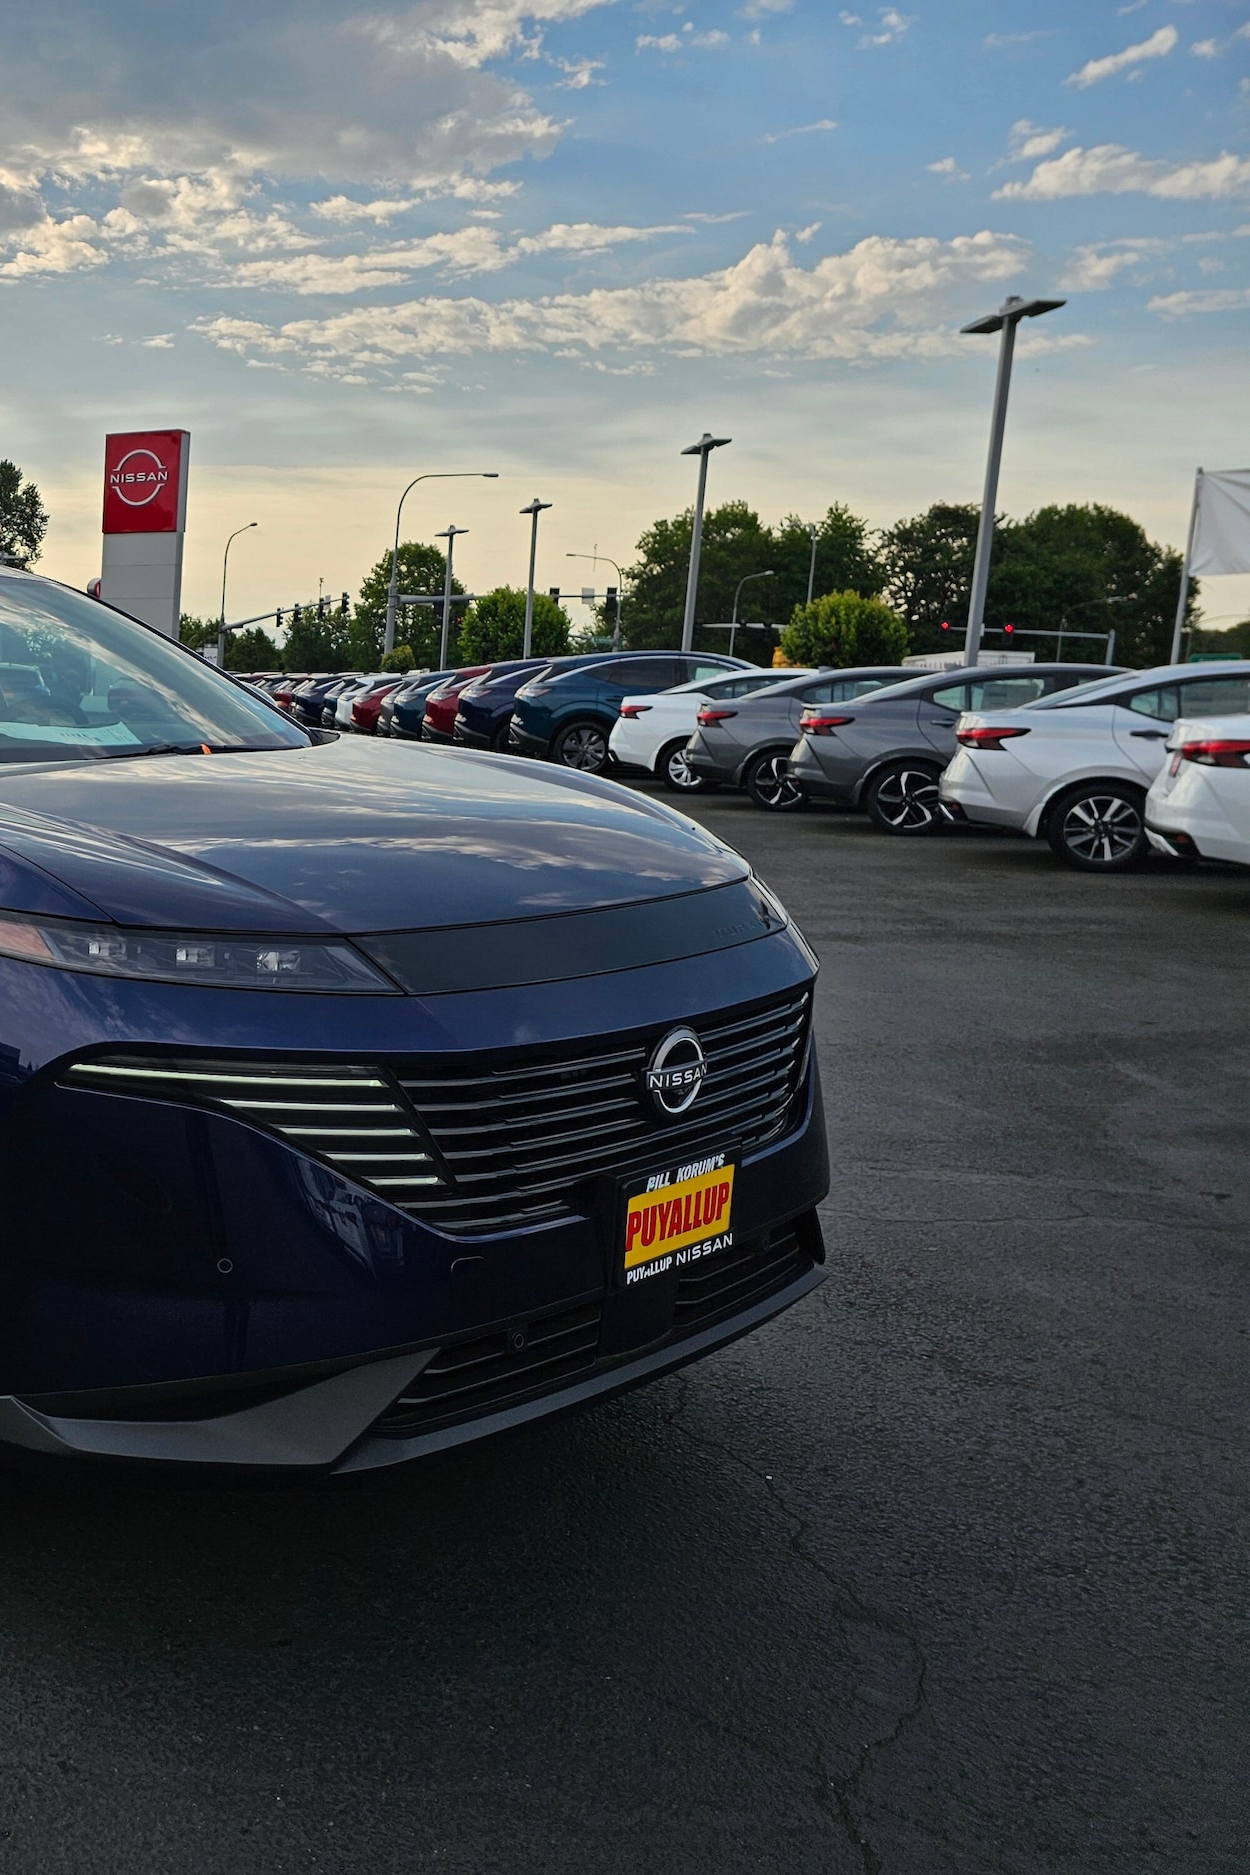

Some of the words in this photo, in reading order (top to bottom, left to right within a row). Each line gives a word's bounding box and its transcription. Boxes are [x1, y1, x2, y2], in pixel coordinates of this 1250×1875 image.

[110, 471, 168, 483] NISSAN
[649, 1061, 707, 1088] NISSAN
[676, 1153, 725, 1183] KORUM'S
[625, 1182, 730, 1252] PUYALLUP
[626, 1256, 672, 1285] PUYALLUP
[676, 1233, 733, 1266] NISSAN
